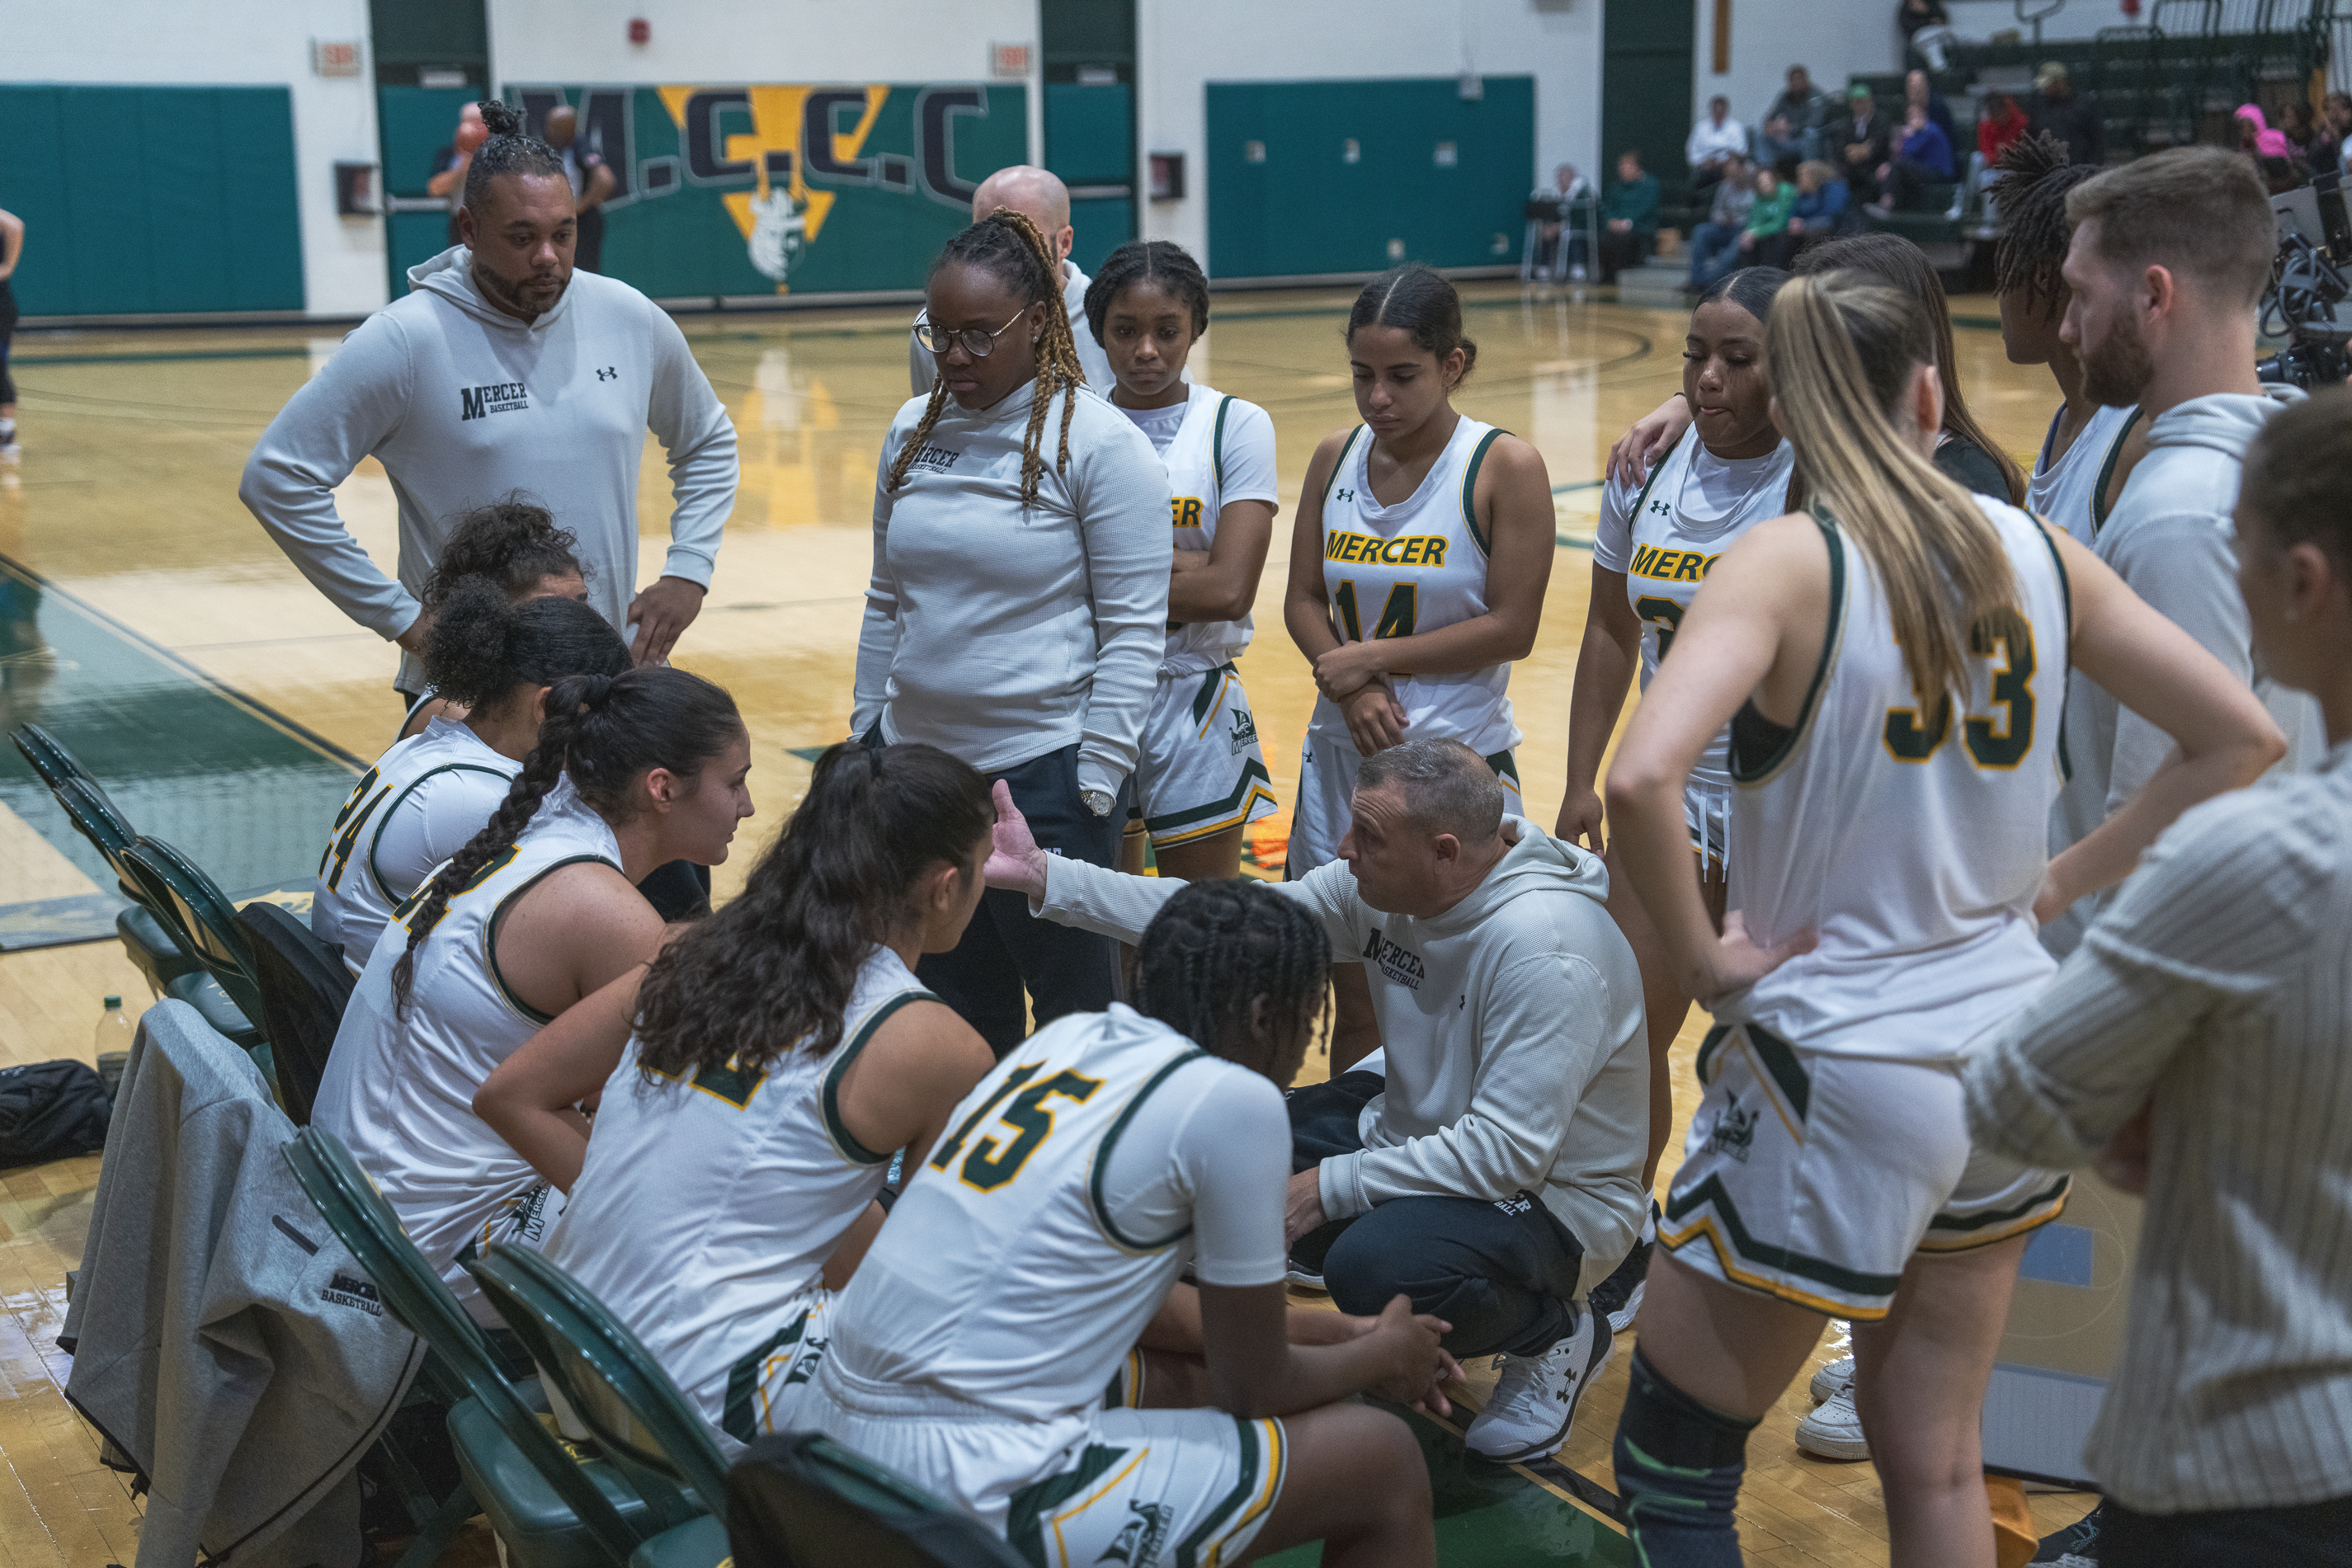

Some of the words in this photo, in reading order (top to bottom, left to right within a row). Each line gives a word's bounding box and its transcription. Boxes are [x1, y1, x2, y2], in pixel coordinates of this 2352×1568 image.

[460, 383, 527, 421] MERCER
[489, 400, 529, 413] BASKETBALL
[913, 446, 960, 468] ERCER
[1325, 529, 1449, 567] MERCER
[1335, 578, 1418, 642] 14
[1231, 732, 1259, 756] MERCE
[1382, 964, 1420, 991] SKETBALL
[929, 1058, 1107, 1194] 15
[320, 1288, 382, 1317] BASKETBALL
